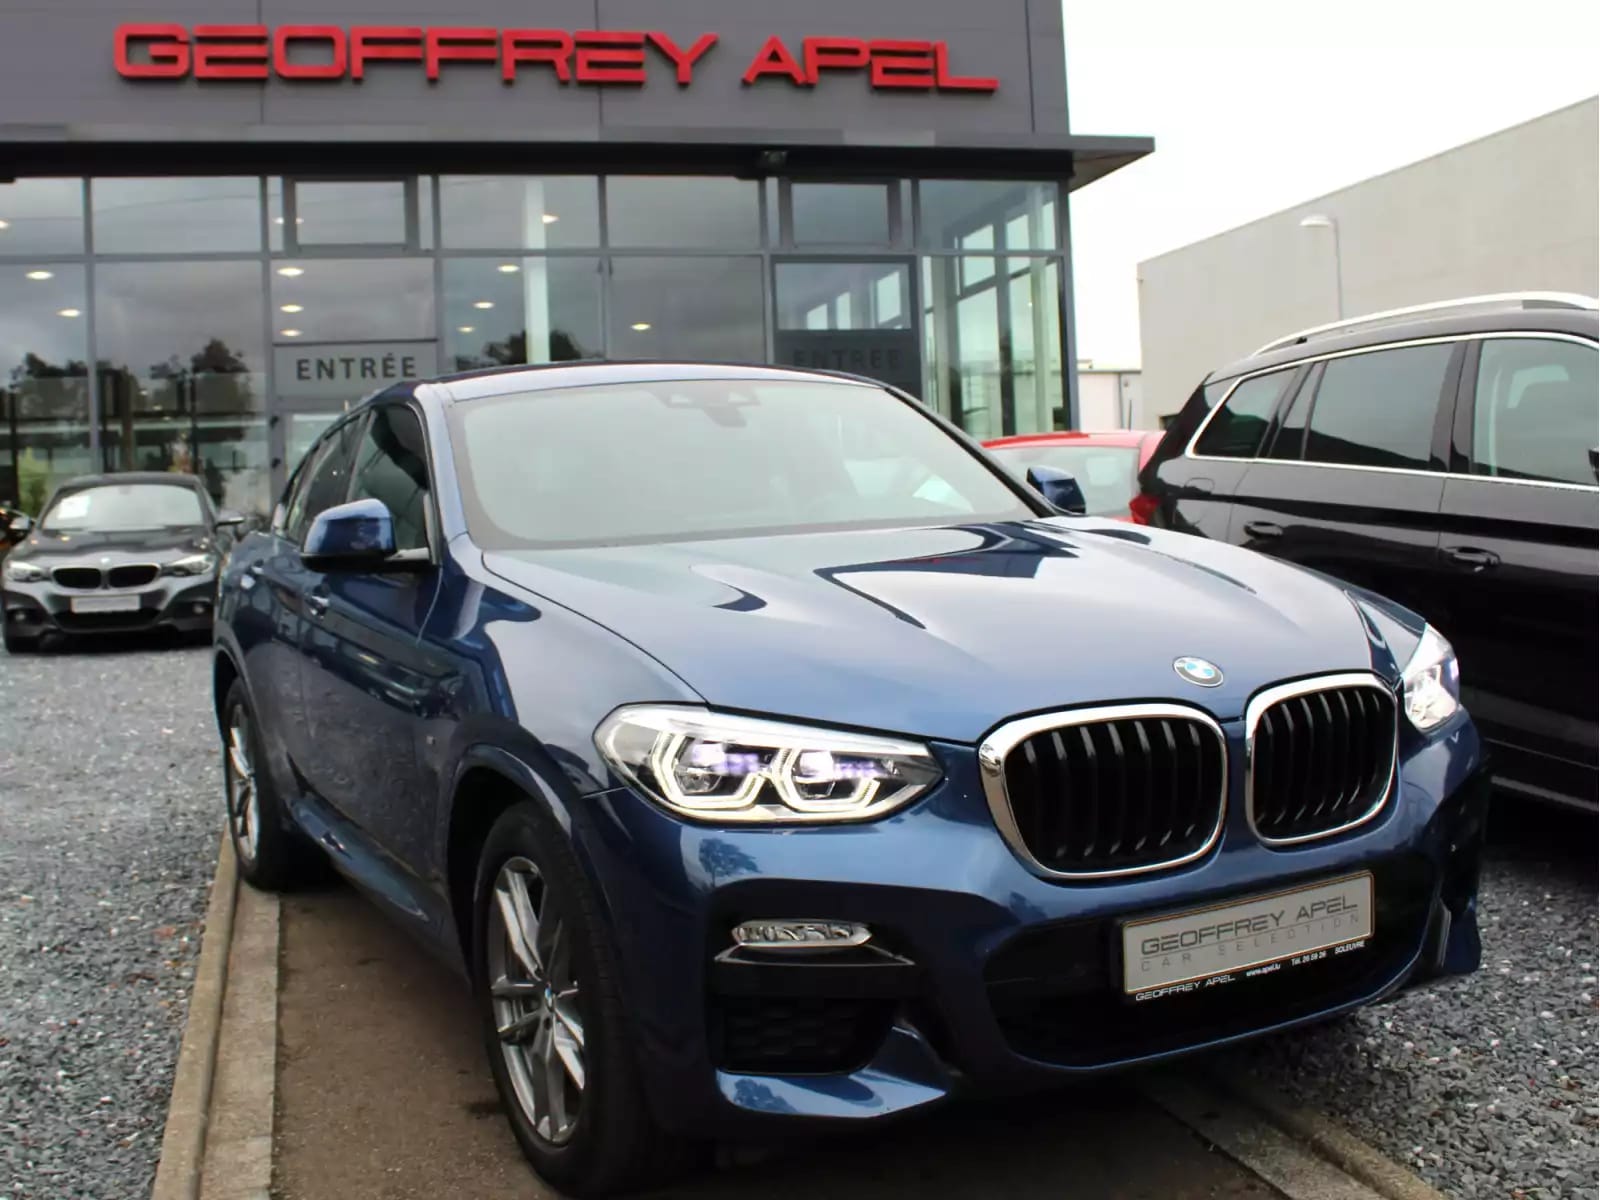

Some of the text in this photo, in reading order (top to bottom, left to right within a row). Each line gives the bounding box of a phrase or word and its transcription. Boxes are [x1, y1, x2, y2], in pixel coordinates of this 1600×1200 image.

[114, 23, 999, 92] GEOFFREY APEL
[296, 352, 417, 381] ENTRÉE
[1141, 893, 1359, 956] GEOFFREY APEL
[1141, 953, 1192, 972] CAR
[1135, 980, 1201, 1002] GEOFFREY
[1205, 974, 1237, 988] APEL
